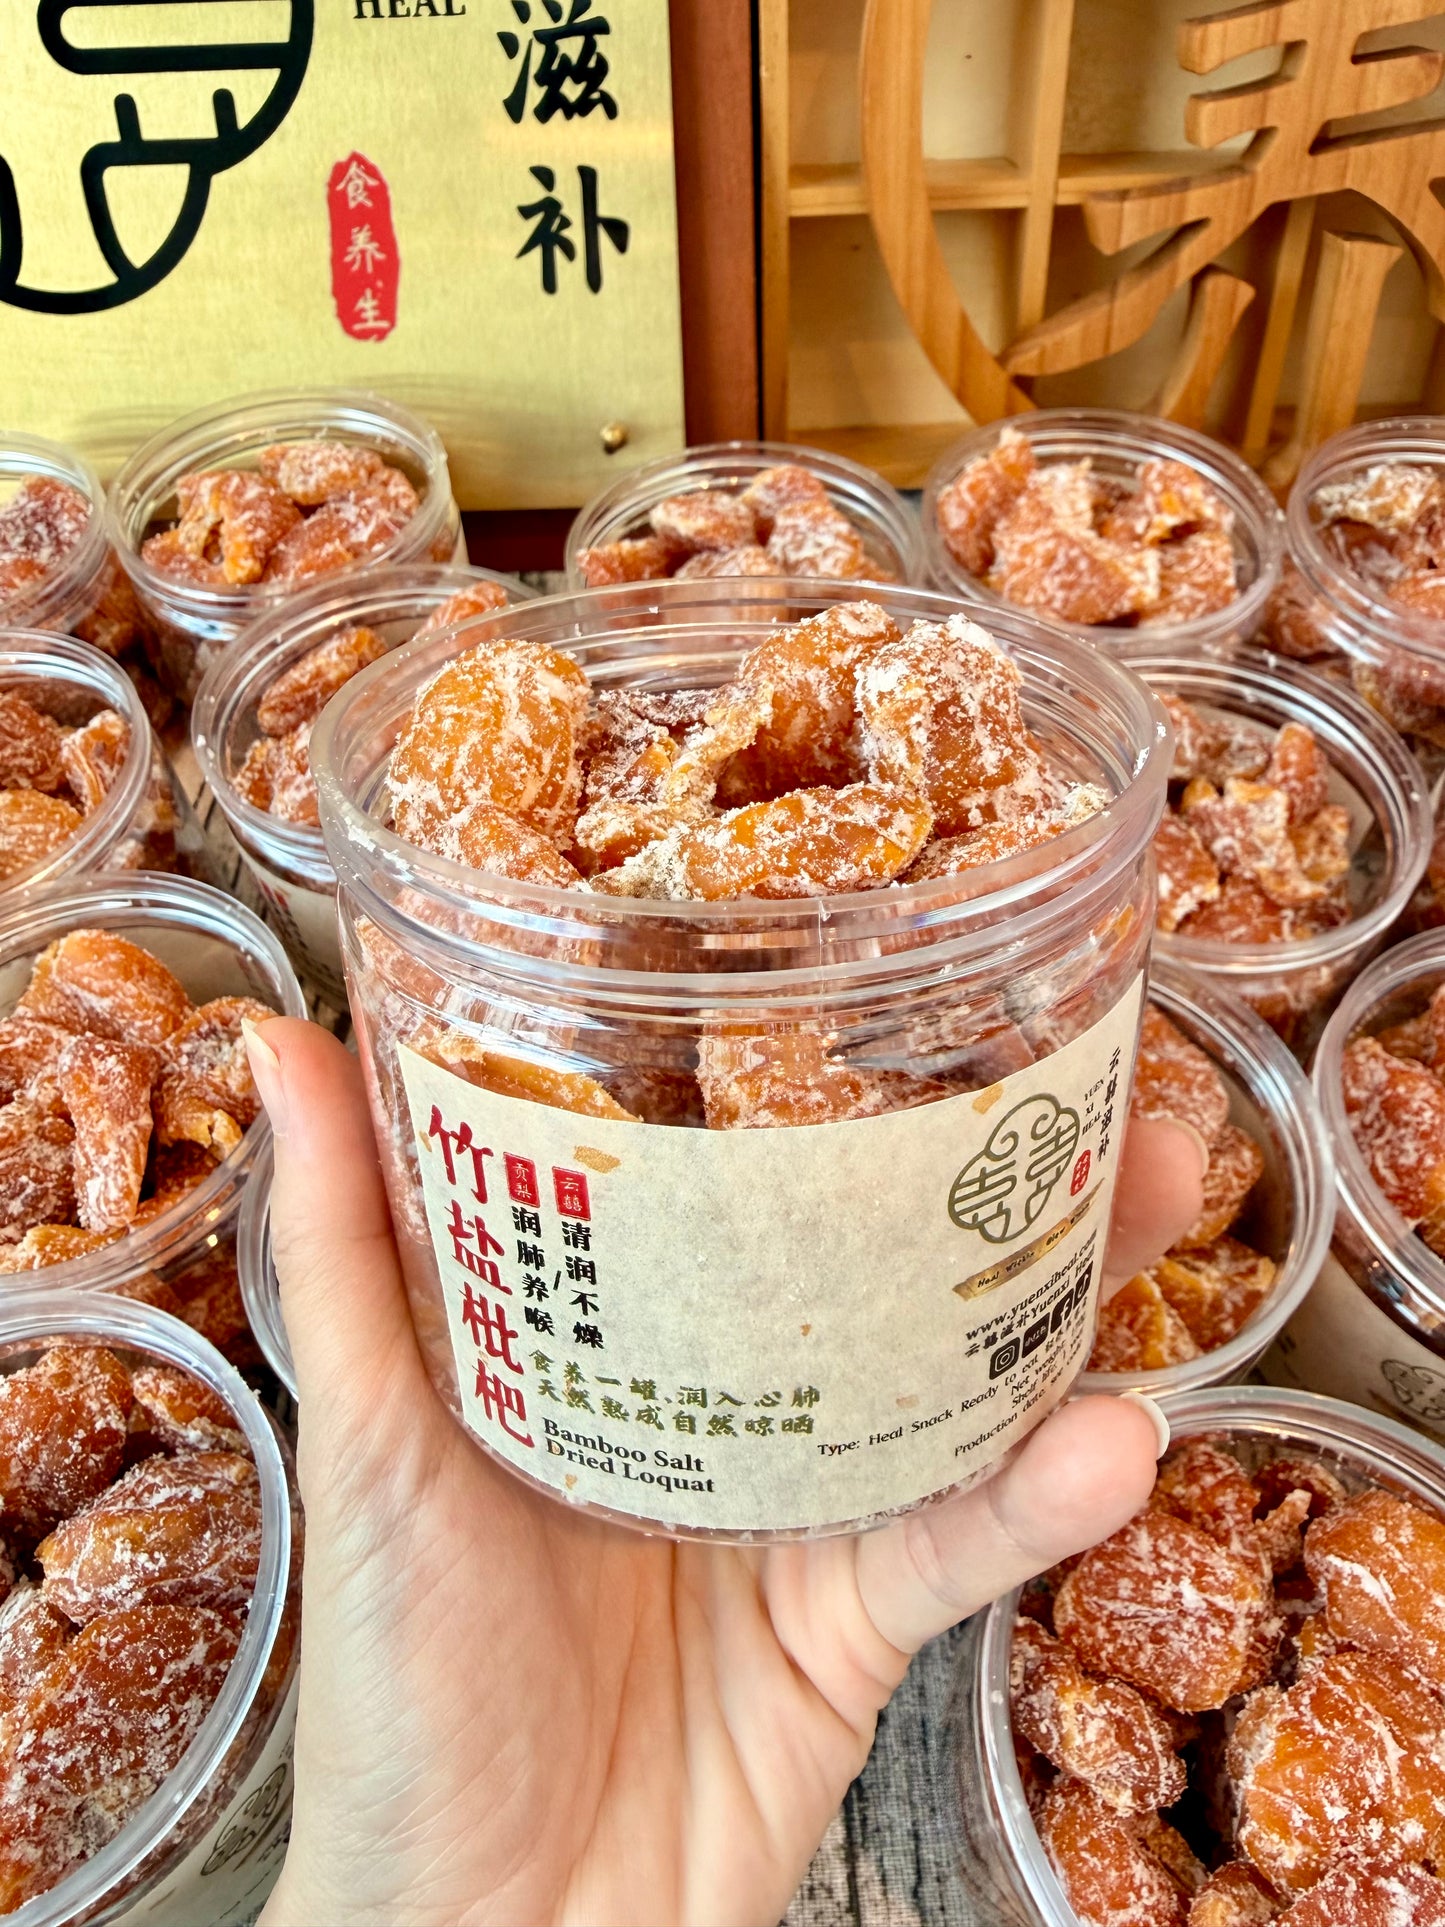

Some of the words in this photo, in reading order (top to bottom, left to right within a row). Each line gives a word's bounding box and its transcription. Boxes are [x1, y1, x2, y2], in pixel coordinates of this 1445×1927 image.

[497, 0, 629, 294] 滋补
[336, 161, 390, 331] 食养生
[429, 1104, 535, 1448] 竹盐枇杷
[511, 1206, 555, 1336] 润肺养喉
[561, 1221, 604, 1349] 清润不燥
[542, 1417, 647, 1464] Bamboo
[654, 1449, 705, 1474] Salt
[545, 1437, 615, 1475] Dried
[622, 1463, 715, 1494] Loquat
[817, 1438, 861, 1457] Type:
[868, 1426, 904, 1446] Heal
[910, 1409, 953, 1434] Snack
[960, 1384, 999, 1413] Ready
[1005, 1373, 1017, 1387] to
[1022, 1353, 1039, 1374] eat
[954, 1412, 1018, 1456] Production
